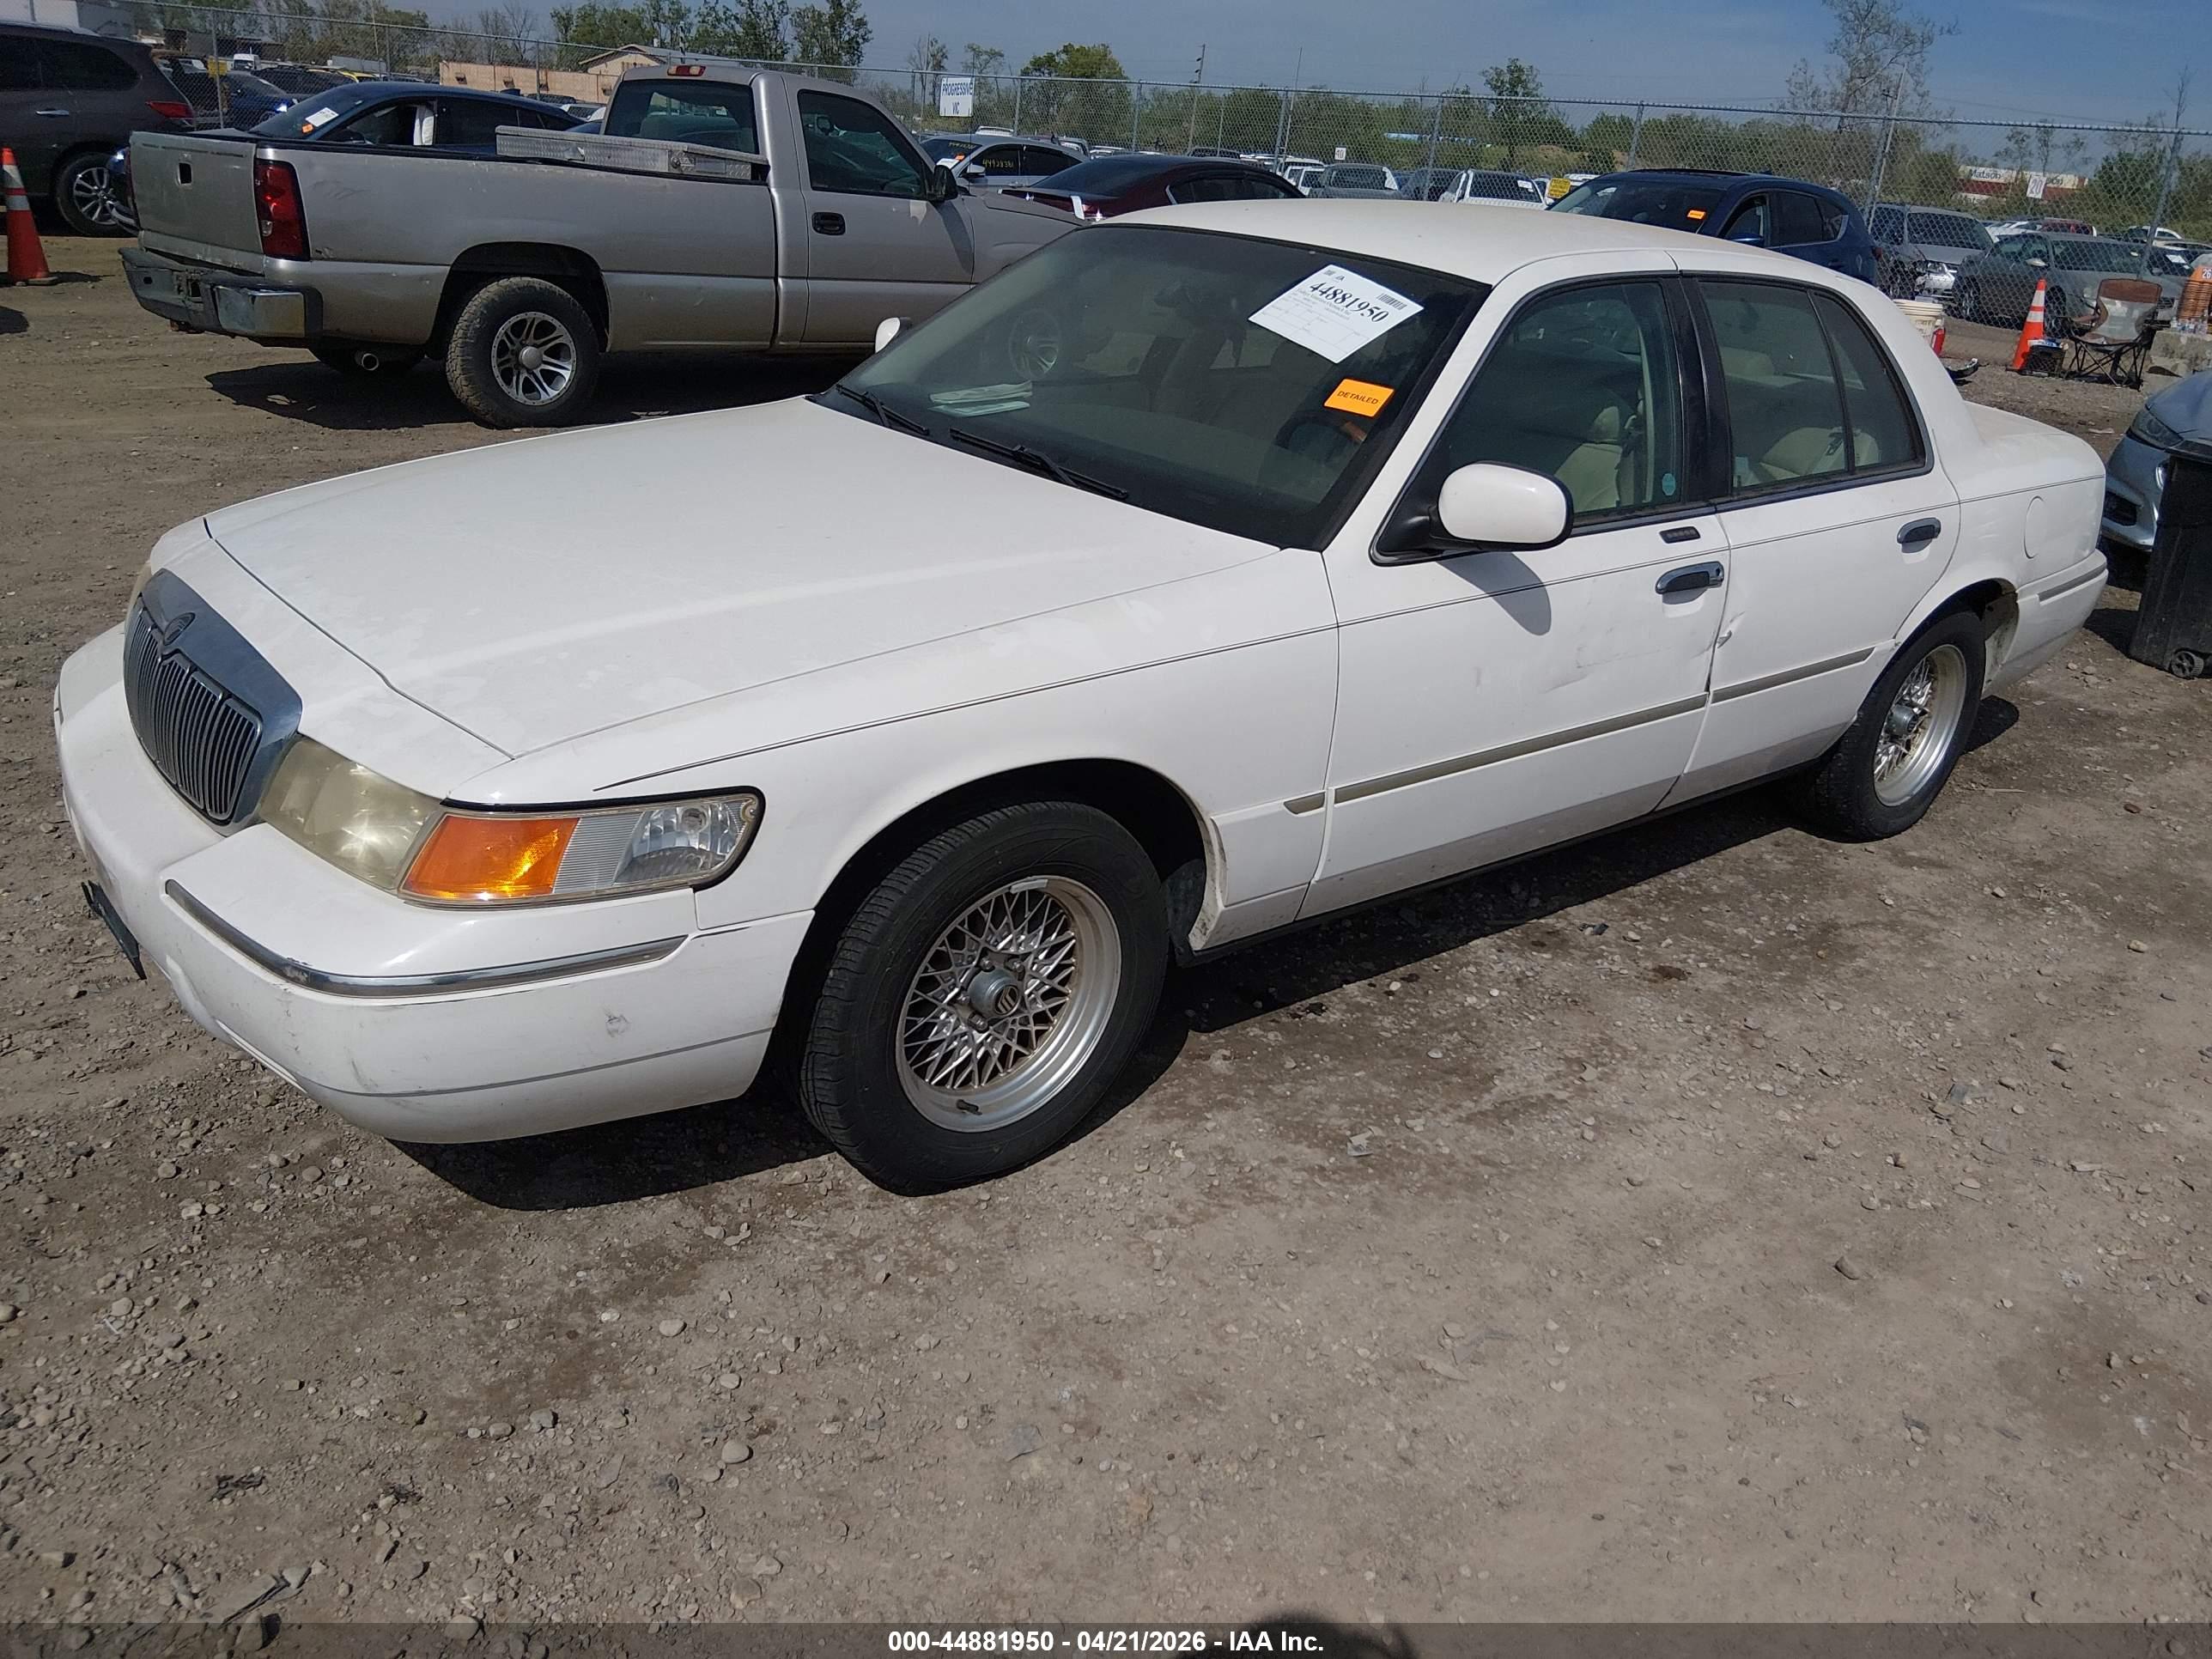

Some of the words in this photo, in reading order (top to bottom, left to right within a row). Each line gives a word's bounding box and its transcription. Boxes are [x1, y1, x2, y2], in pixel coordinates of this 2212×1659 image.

[942, 82, 973, 96] PROGRESSIVE
[2030, 178, 2043, 195] 20
[1310, 281, 1389, 323] 44881950
[1336, 390, 1378, 405] DETAILED
